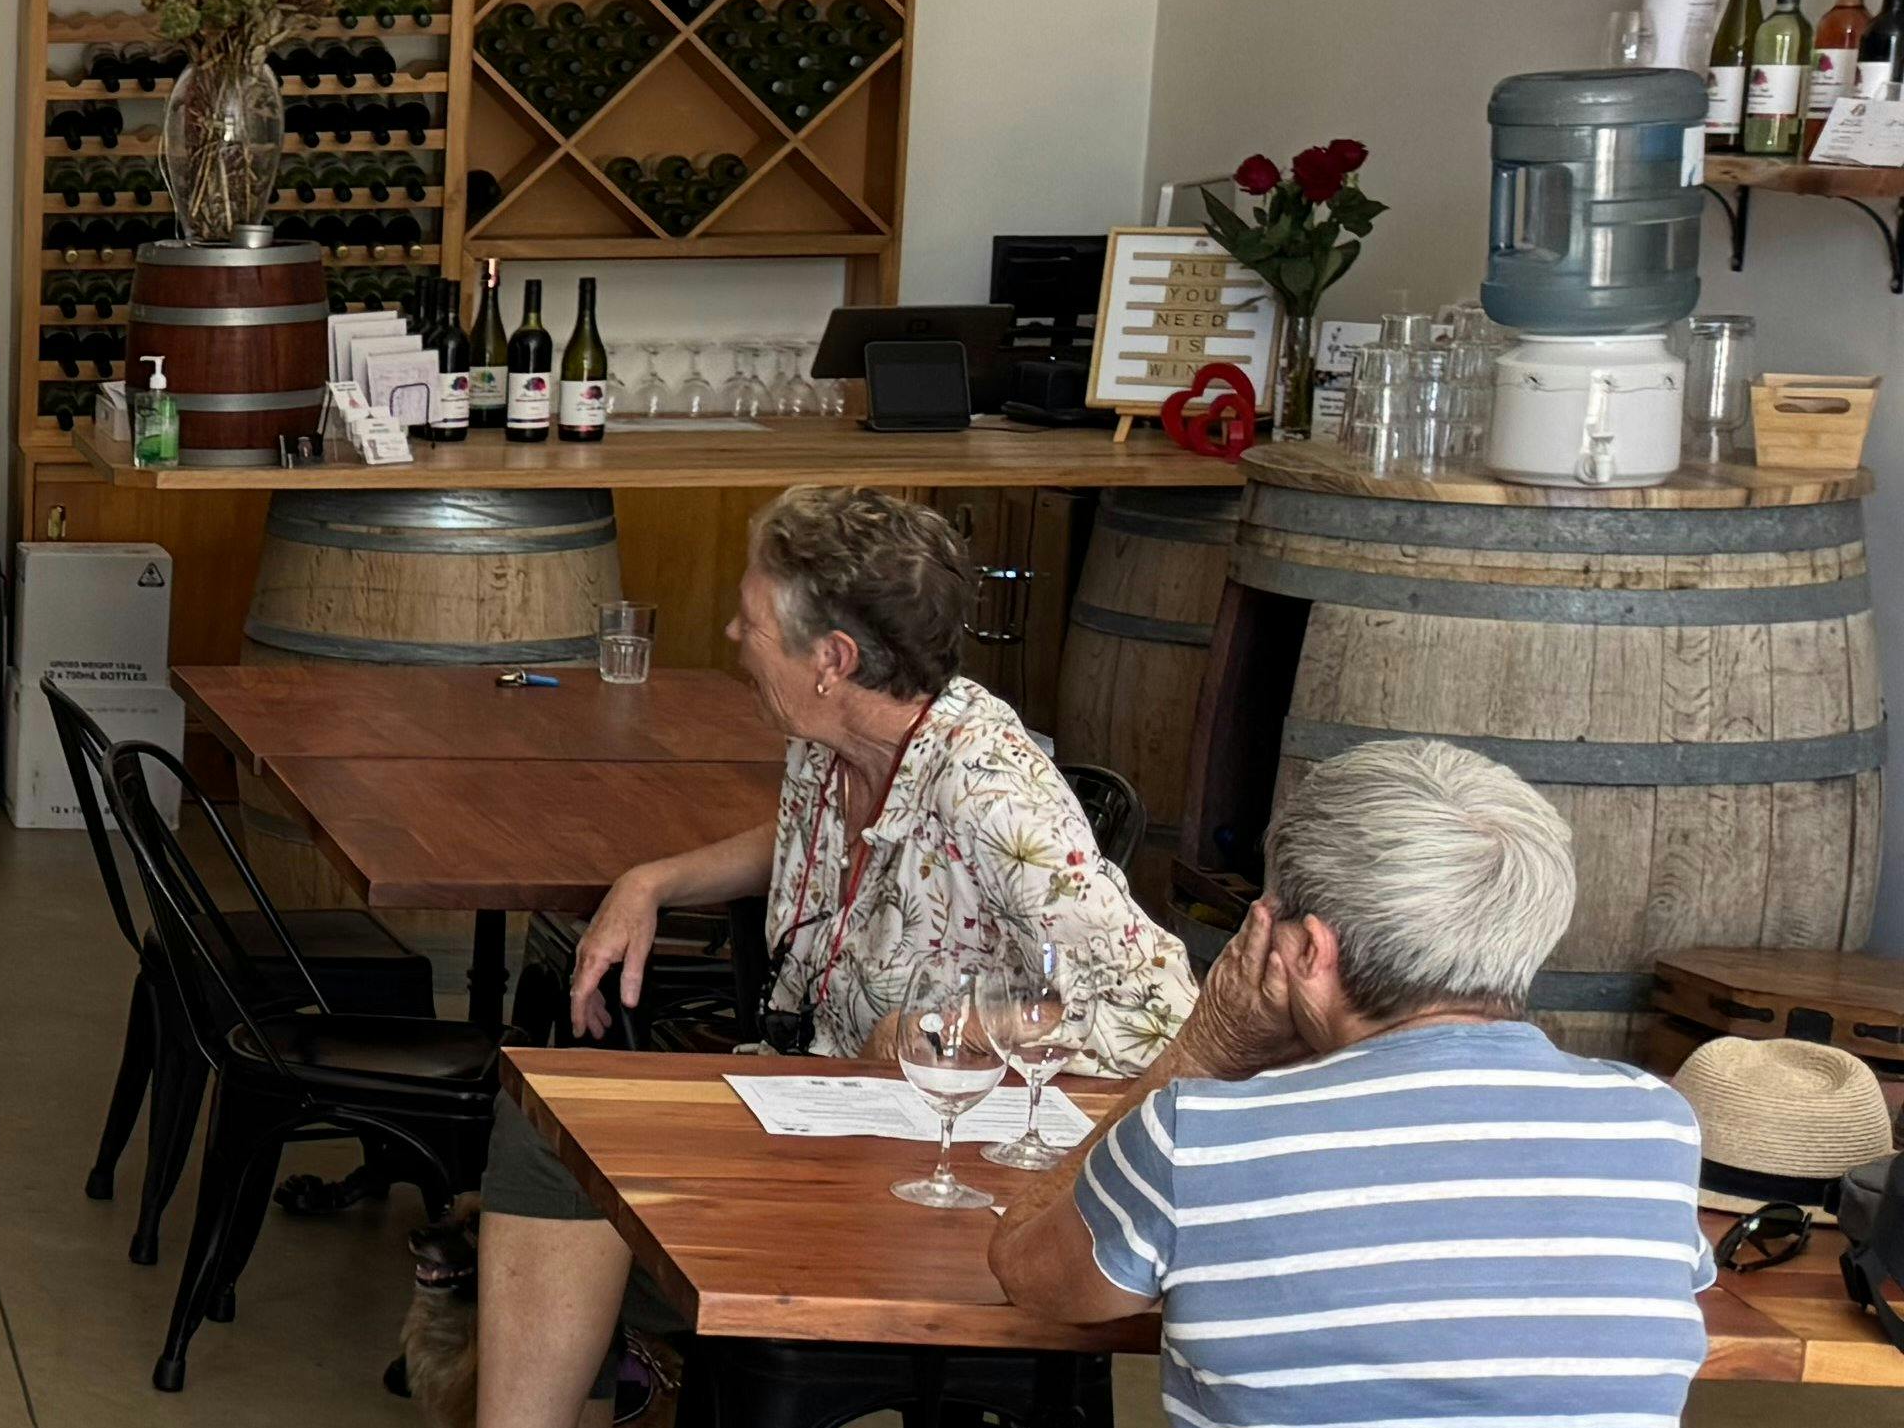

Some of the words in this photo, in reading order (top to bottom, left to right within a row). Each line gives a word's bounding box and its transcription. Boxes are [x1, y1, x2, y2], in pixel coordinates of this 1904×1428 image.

[1171, 262, 1223, 277] ALL
[1168, 287, 1218, 303] YOU
[1155, 313, 1226, 328] NEED
[1175, 339, 1202, 353] IS
[1149, 362, 1201, 378] WIN
[99, 672, 147, 682] BOTTLES
